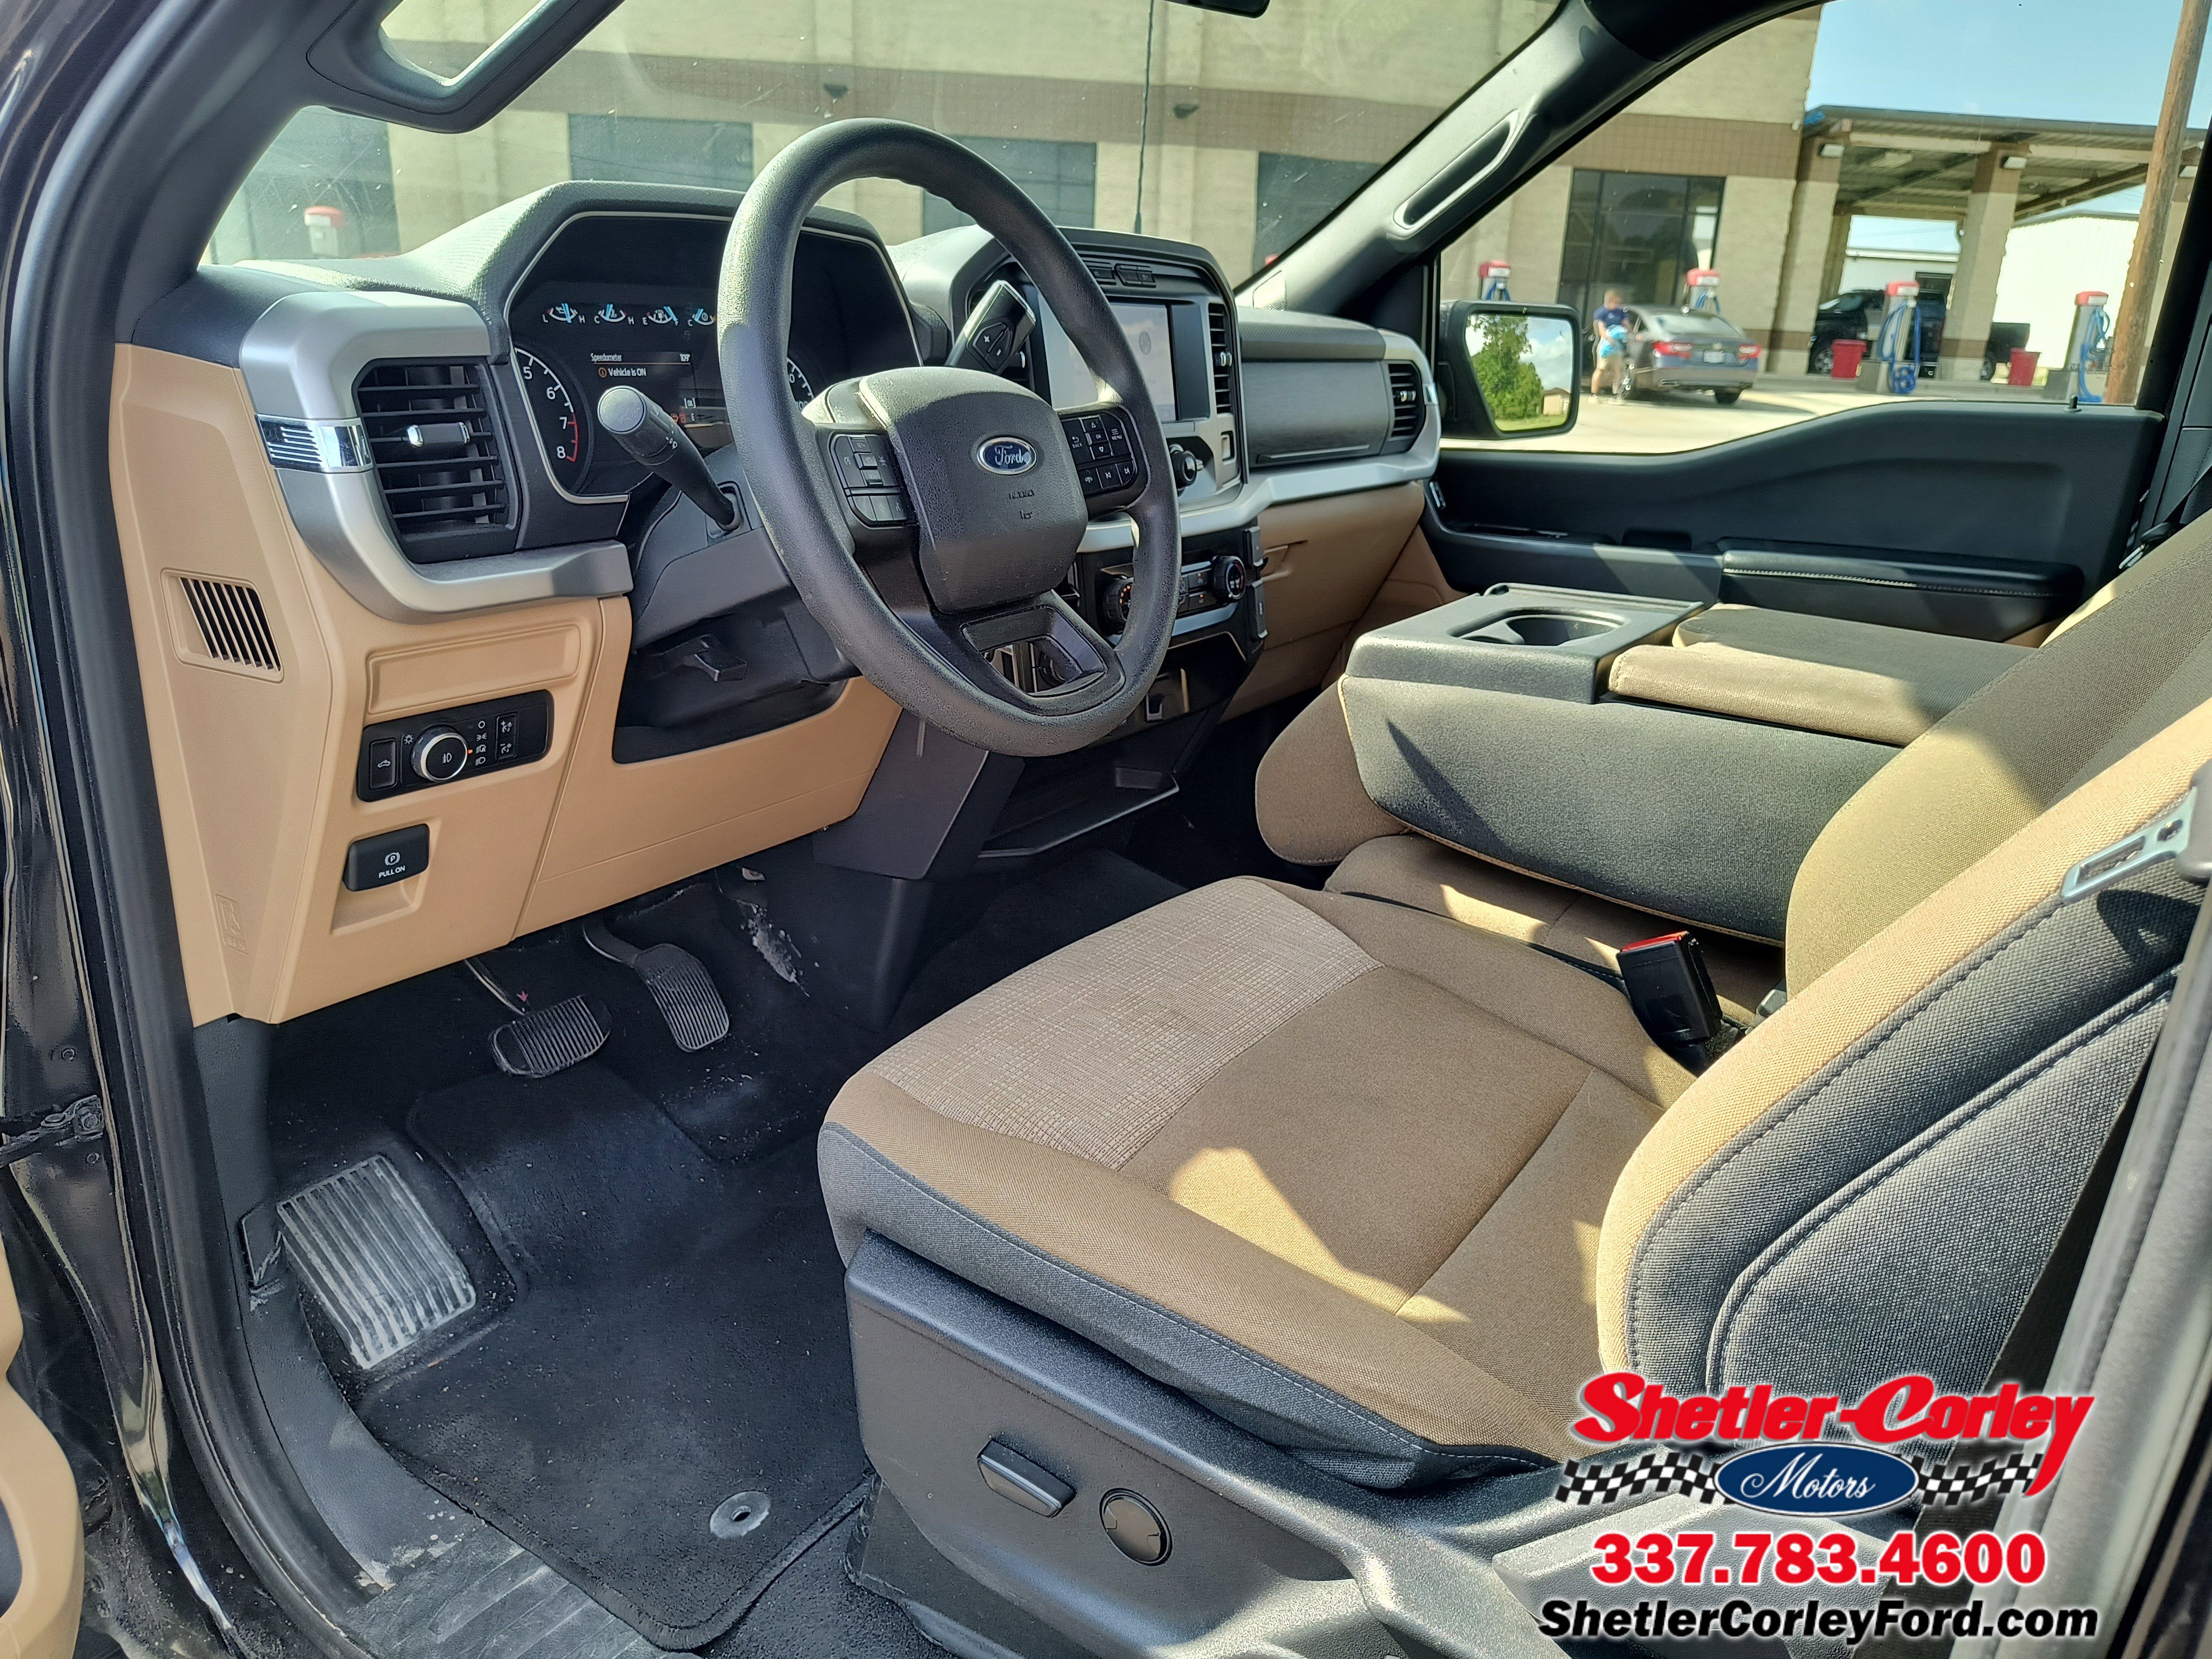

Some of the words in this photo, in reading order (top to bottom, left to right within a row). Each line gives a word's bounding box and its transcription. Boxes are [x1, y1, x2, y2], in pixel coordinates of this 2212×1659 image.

[542, 314, 548, 323] L
[578, 315, 585, 323] H
[594, 315, 600, 324] C
[628, 316, 635, 325] H
[642, 317, 648, 325] E
[590, 353, 622, 362] Speedometer
[523, 366, 532, 379] 5
[608, 368, 631, 376] Vehicle
[637, 368, 646, 376] ON
[547, 387, 556, 400] 6
[559, 416, 567, 429] 7
[556, 446, 566, 458] 8
[994, 445, 1023, 466] Ford
[379, 868, 395, 879] PULL
[395, 865, 406, 873] ON
